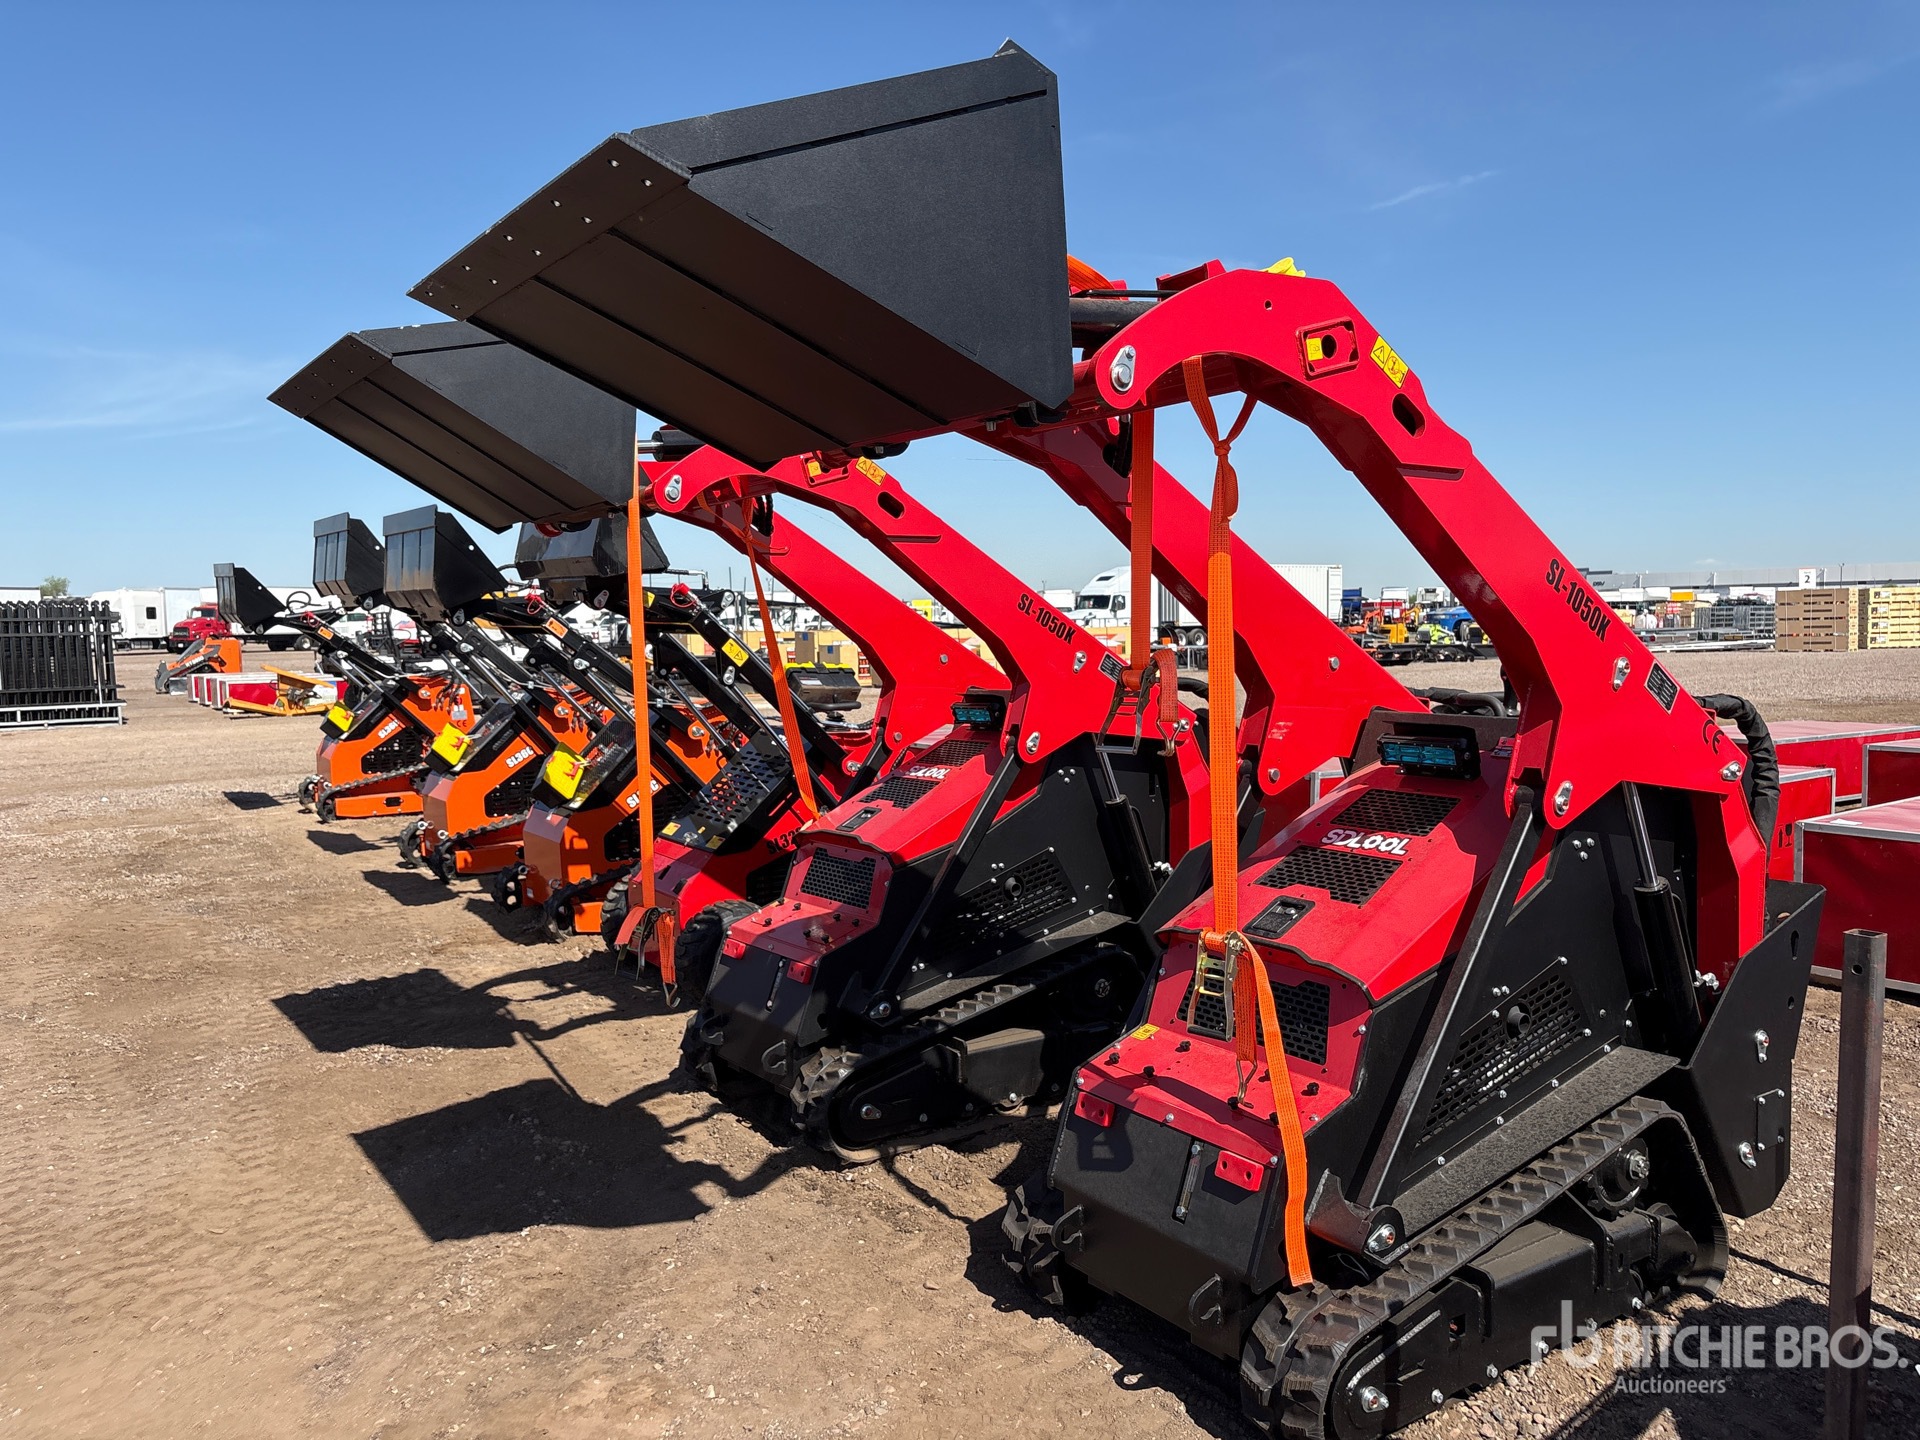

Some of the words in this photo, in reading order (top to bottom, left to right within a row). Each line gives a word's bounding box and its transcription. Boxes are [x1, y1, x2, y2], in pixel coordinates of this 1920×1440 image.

[1804, 574, 1811, 584] 2
[1546, 559, 1611, 642] SL-1050K
[1018, 593, 1076, 645] SL-1050K
[626, 779, 660, 808] SLC
[1321, 828, 1411, 856] SDLOOL
